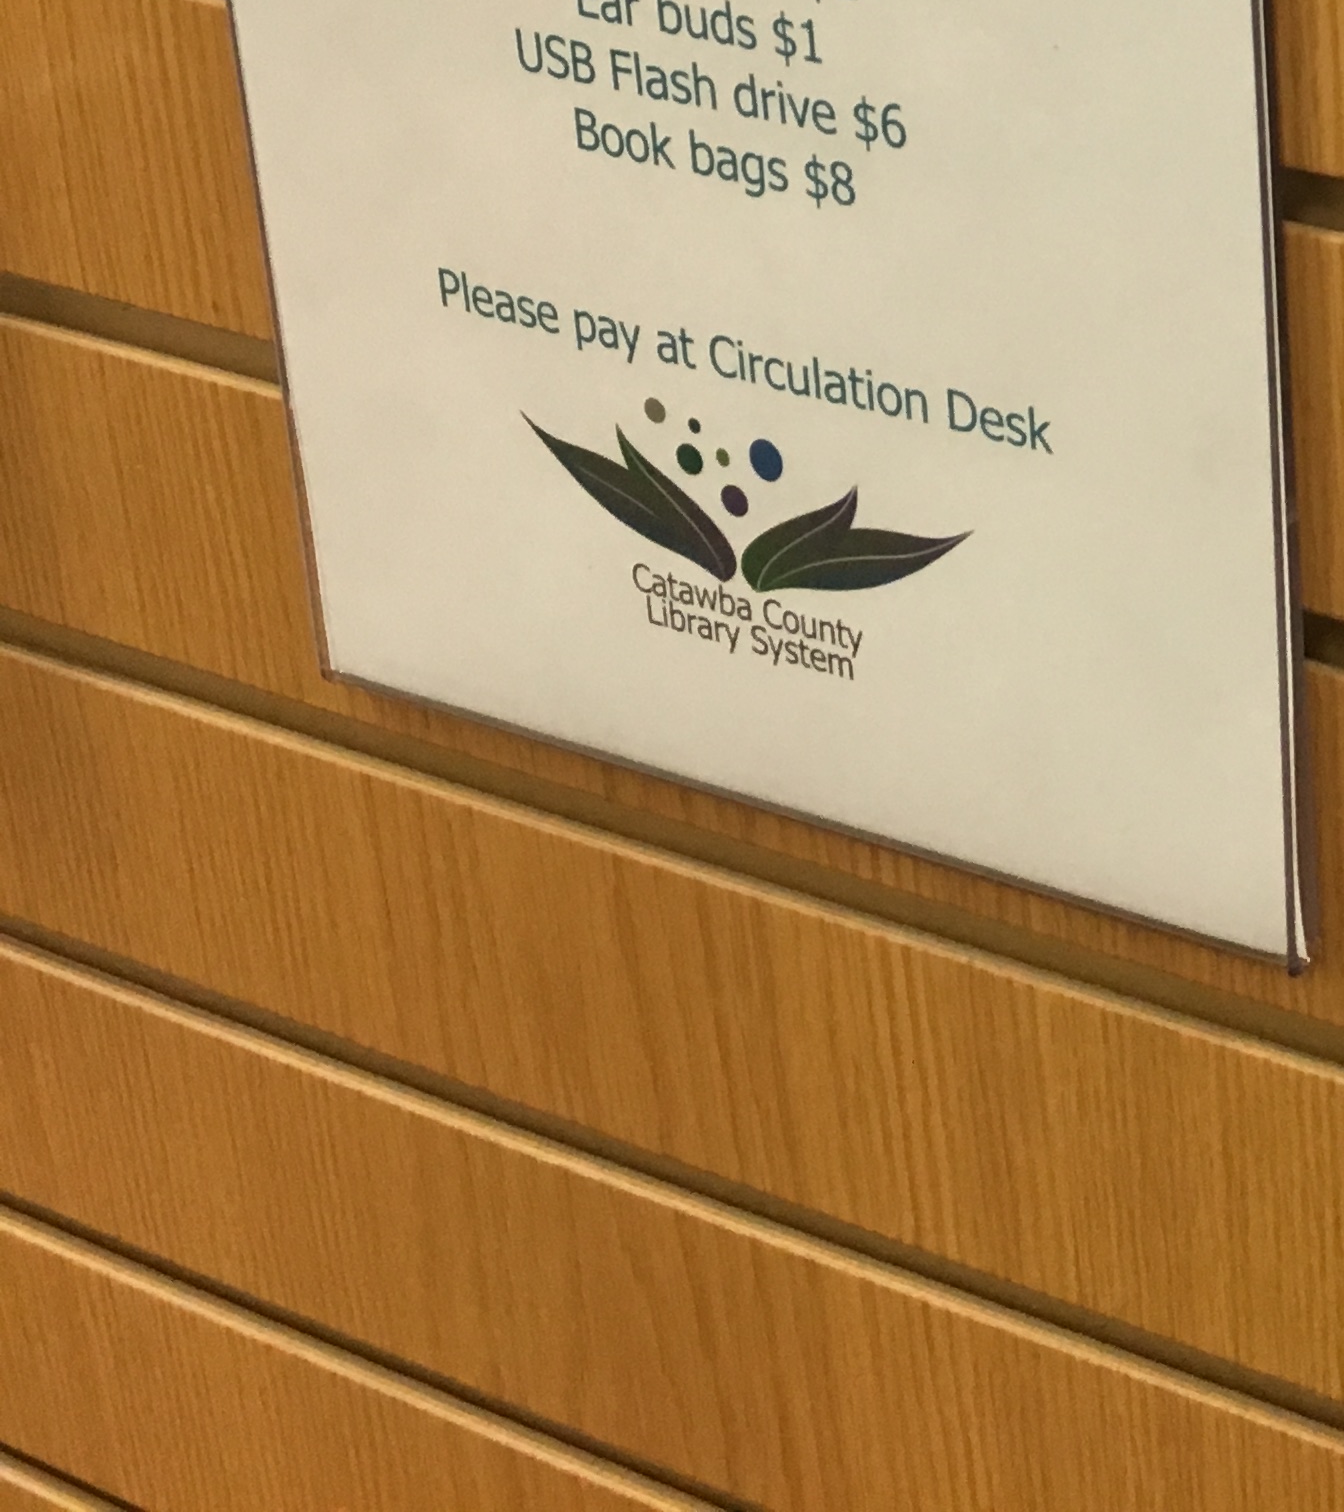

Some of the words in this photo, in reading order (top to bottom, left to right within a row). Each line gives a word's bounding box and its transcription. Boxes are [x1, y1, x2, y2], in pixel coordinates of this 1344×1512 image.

[772, 11, 822, 67] $1
[515, 27, 596, 84] USB
[609, 49, 717, 110] Flash
[734, 73, 837, 135] drive
[853, 95, 907, 152] $6
[574, 107, 676, 170] Book
[689, 129, 789, 198] bags
[804, 154, 856, 209] $8
[438, 267, 560, 334] Please
[574, 309, 640, 364] pay
[657, 327, 697, 370] at
[709, 335, 928, 424] Circulation
[947, 388, 1054, 455] Desk
[632, 563, 751, 622] Catawba
[763, 598, 864, 658] County
[646, 596, 740, 655] Library
[750, 625, 856, 681] System
